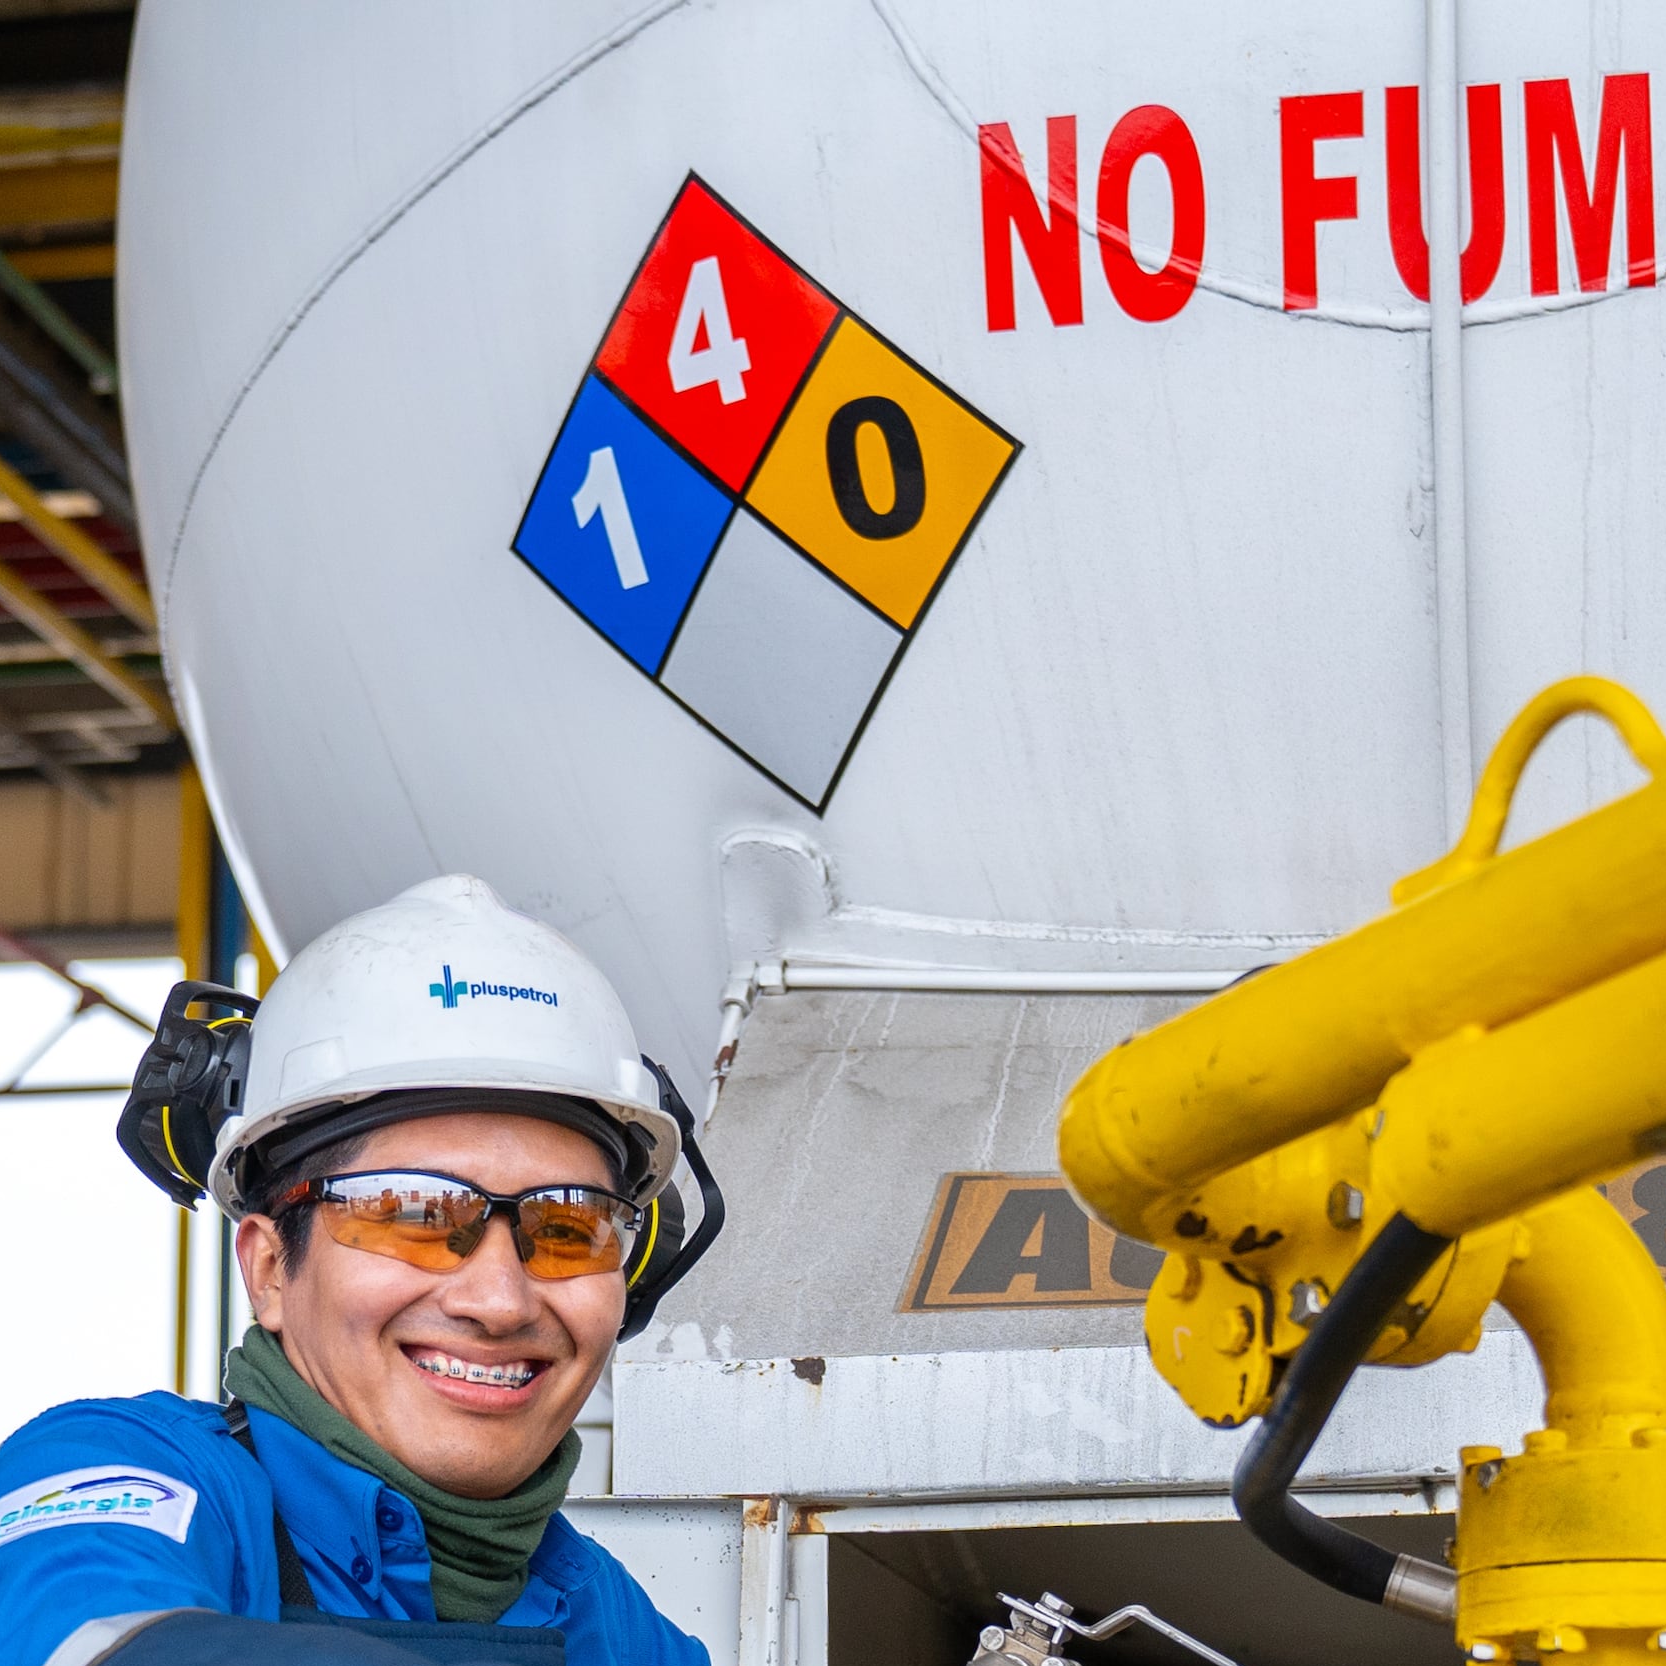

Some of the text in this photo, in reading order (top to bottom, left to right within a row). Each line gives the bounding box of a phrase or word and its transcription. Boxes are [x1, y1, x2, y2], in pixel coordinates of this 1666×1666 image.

[978, 104, 1207, 333] NO
[666, 254, 752, 406] 4
[571, 445, 650, 590] 1
[825, 394, 927, 542] 0
[470, 980, 559, 1008] pluspetrol
